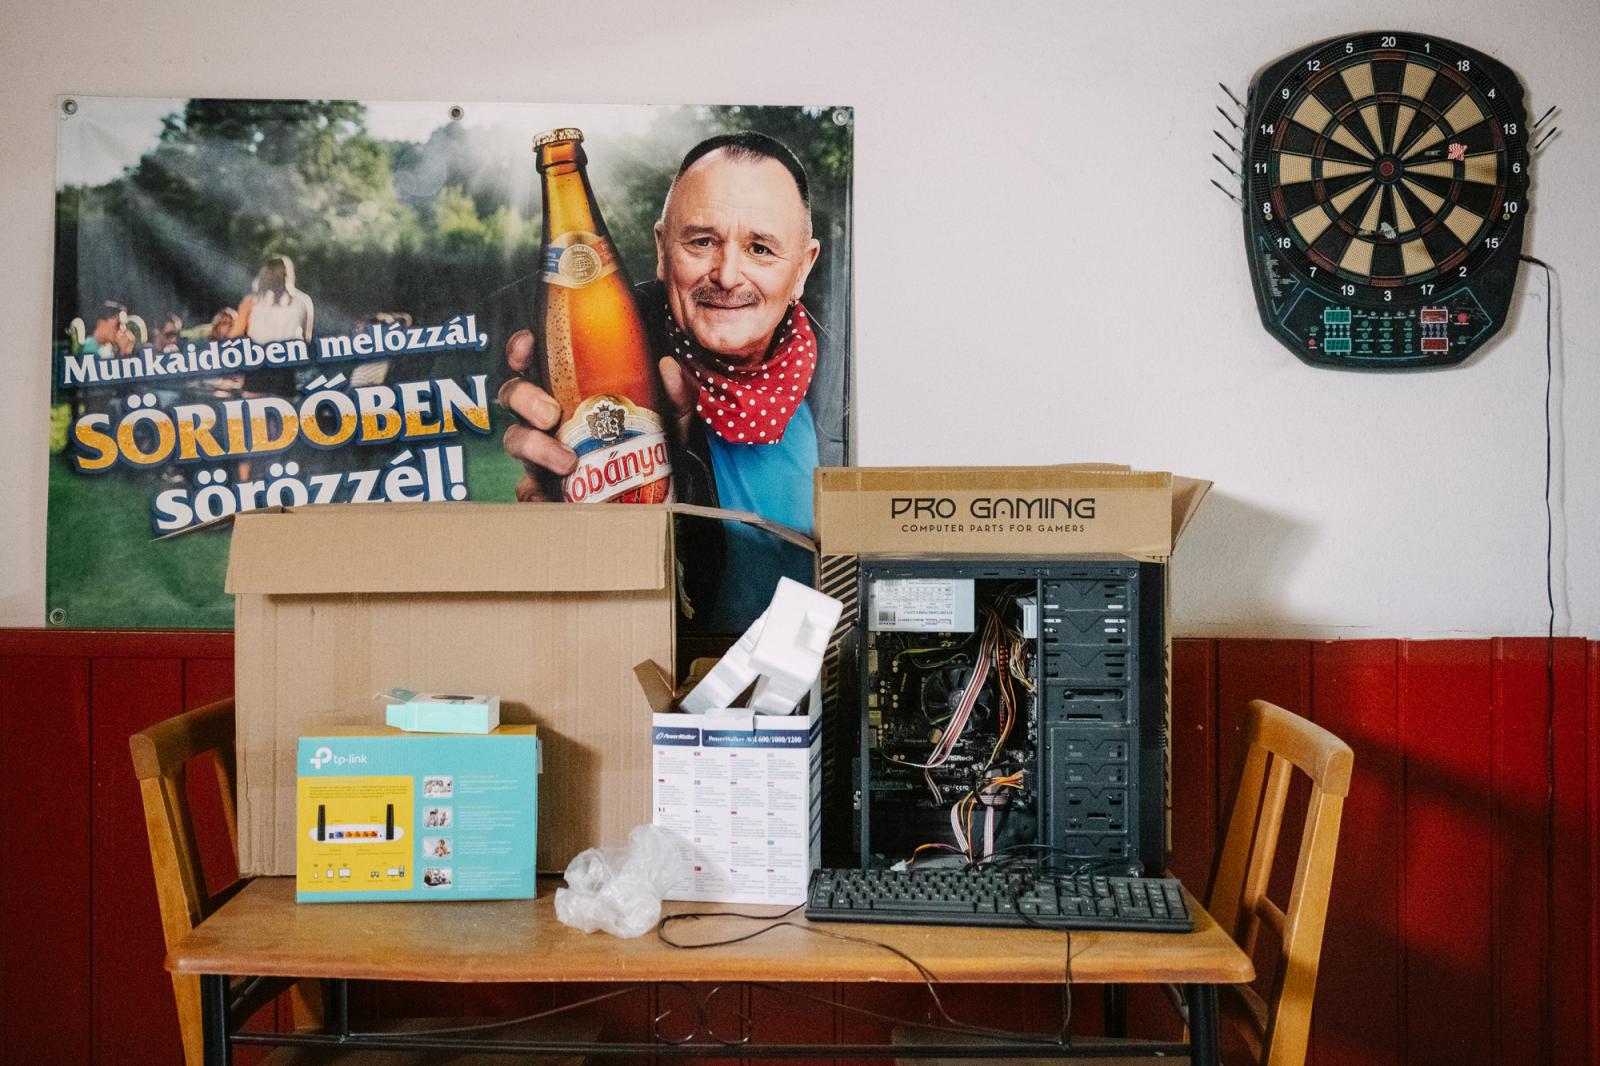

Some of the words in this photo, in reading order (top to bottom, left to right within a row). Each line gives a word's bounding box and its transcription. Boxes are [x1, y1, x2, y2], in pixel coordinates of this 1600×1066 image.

[1382, 36, 1397, 48] 20
[1424, 43, 1430, 53] 1
[1345, 43, 1354, 54] 5
[1306, 60, 1321, 71] 12
[1456, 60, 1470, 72] 18
[1281, 88, 1290, 100] 9
[1487, 88, 1496, 99] 4
[1260, 124, 1275, 135] 14
[1503, 123, 1517, 135] 13
[1254, 163, 1267, 174] 11
[1512, 163, 1521, 174] 6
[1263, 202, 1272, 214] 8
[1504, 201, 1518, 214] 10
[1276, 237, 1291, 249] 16
[1484, 237, 1499, 249] 15
[1309, 266, 1317, 278] 7
[1458, 266, 1467, 278] 2
[1340, 285, 1355, 296] 19
[1383, 290, 1392, 302] 3
[1420, 285, 1435, 296] 17
[63, 337, 309, 385] Munkaidőben
[320, 314, 489, 359] melózzál,
[74, 373, 491, 470] SÖRIDŐBEN
[154, 445, 468, 530] sörözzél!
[891, 497, 957, 520] PRO
[969, 497, 1096, 520] GAMING
[901, 523, 964, 533] COMPUTER
[969, 523, 1004, 533] PARTS
[1009, 523, 1032, 533] FOR
[1037, 523, 1085, 533] GAMERS
[333, 753, 368, 766] tp-link
